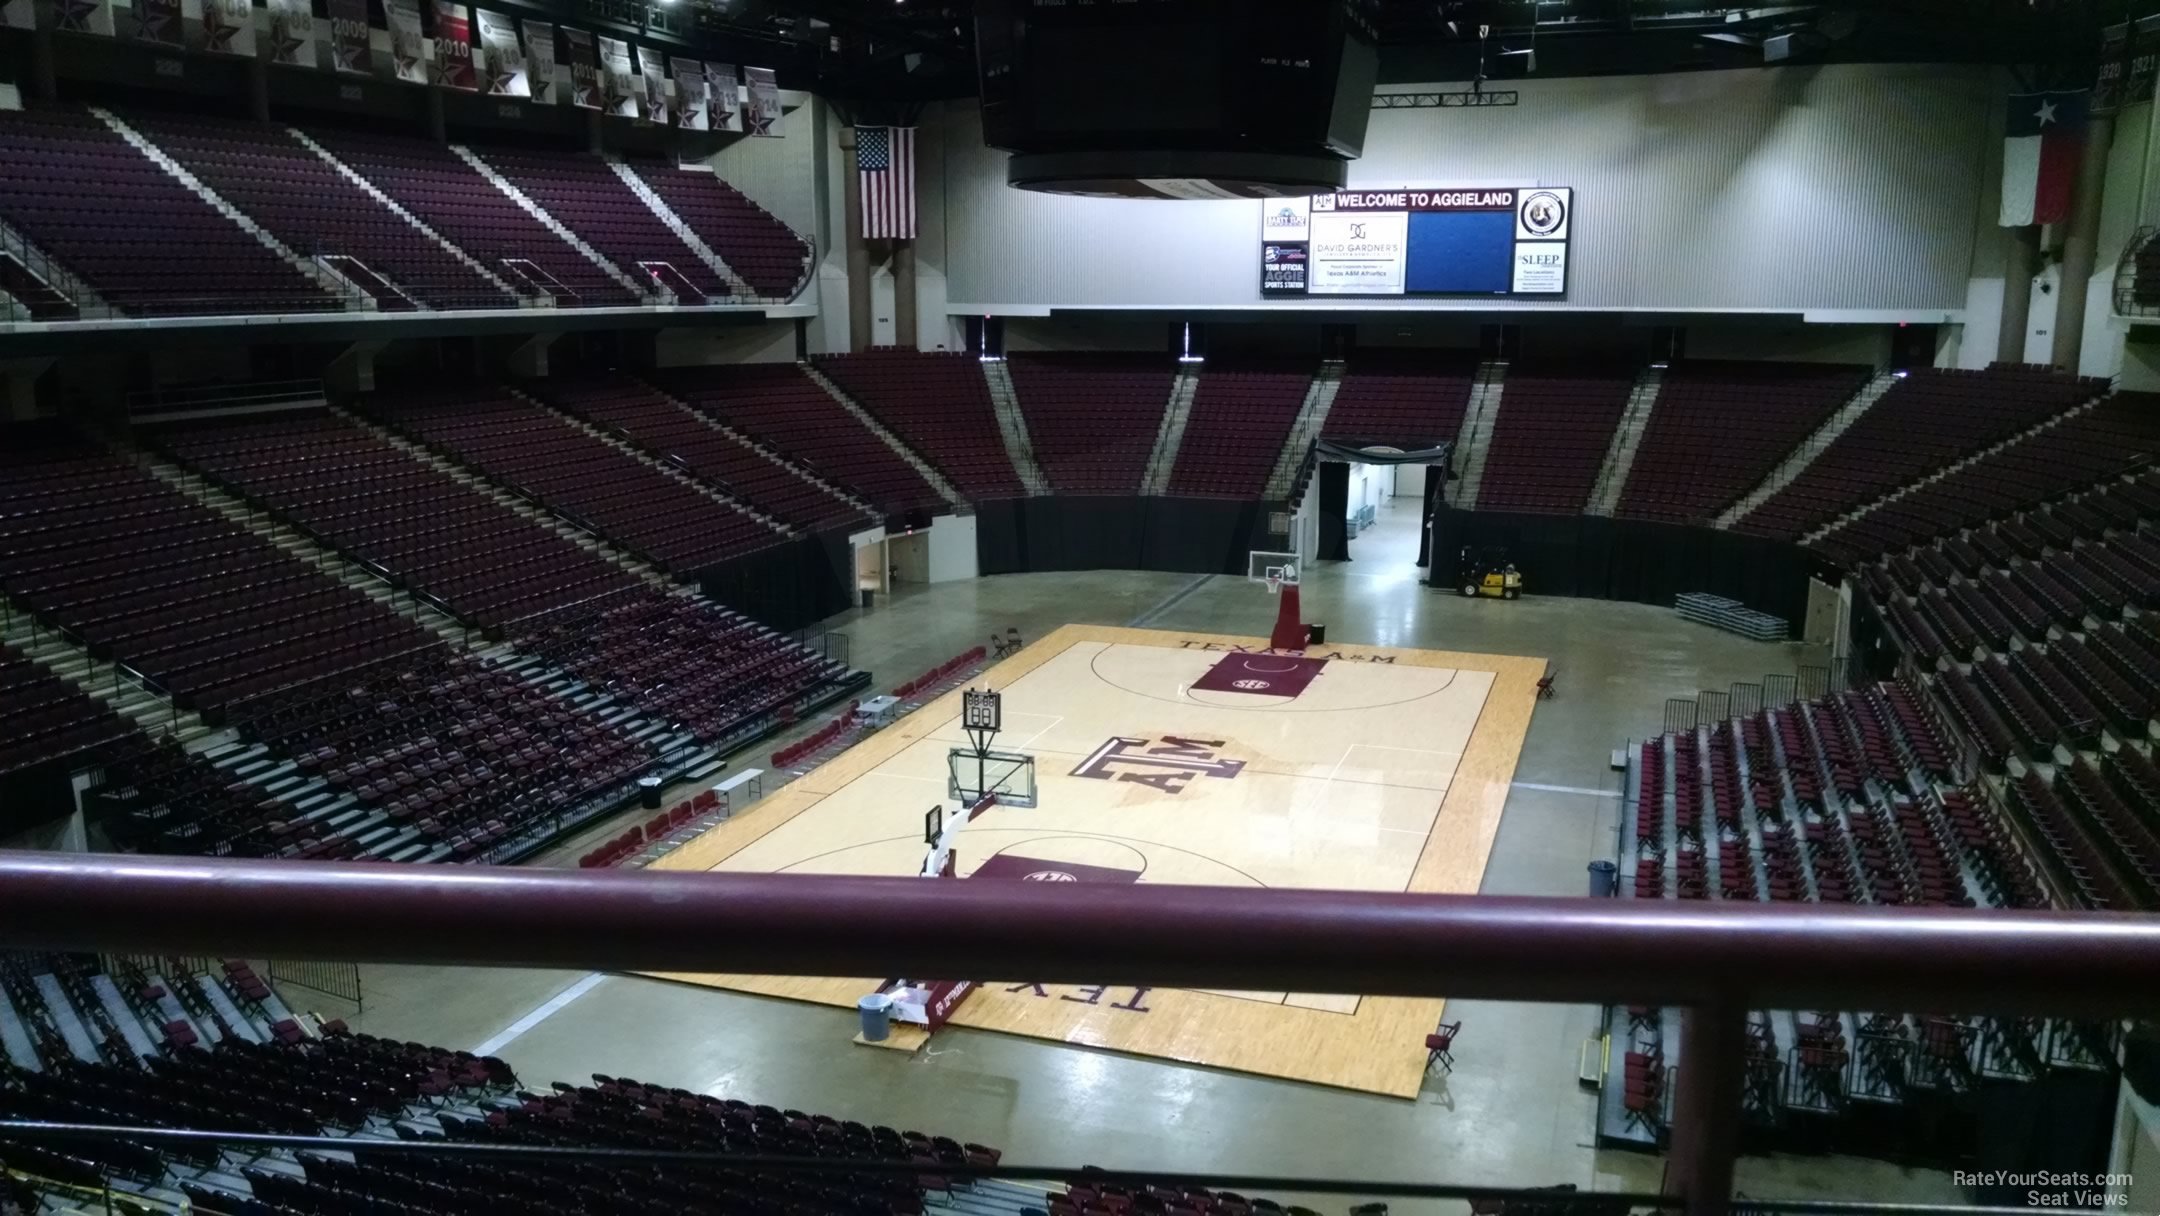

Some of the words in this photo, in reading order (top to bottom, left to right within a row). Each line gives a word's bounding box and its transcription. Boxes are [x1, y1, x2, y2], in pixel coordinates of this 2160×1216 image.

[332, 17, 368, 39] 2009
[434, 37, 469, 59] 2010
[572, 62, 597, 81] 2011
[1337, 194, 1407, 207] WELCOME
[1410, 194, 1428, 206] TO
[1431, 192, 1513, 206] AGGIELAND
[1318, 244, 1345, 253] DAVID
[1348, 243, 1398, 253] GARDNER'S
[1522, 254, 1560, 265] SLEEP
[1265, 264, 1279, 272] YOUR
[1281, 264, 1304, 272] OFFICIAL
[1265, 272, 1304, 281] AGGIE
